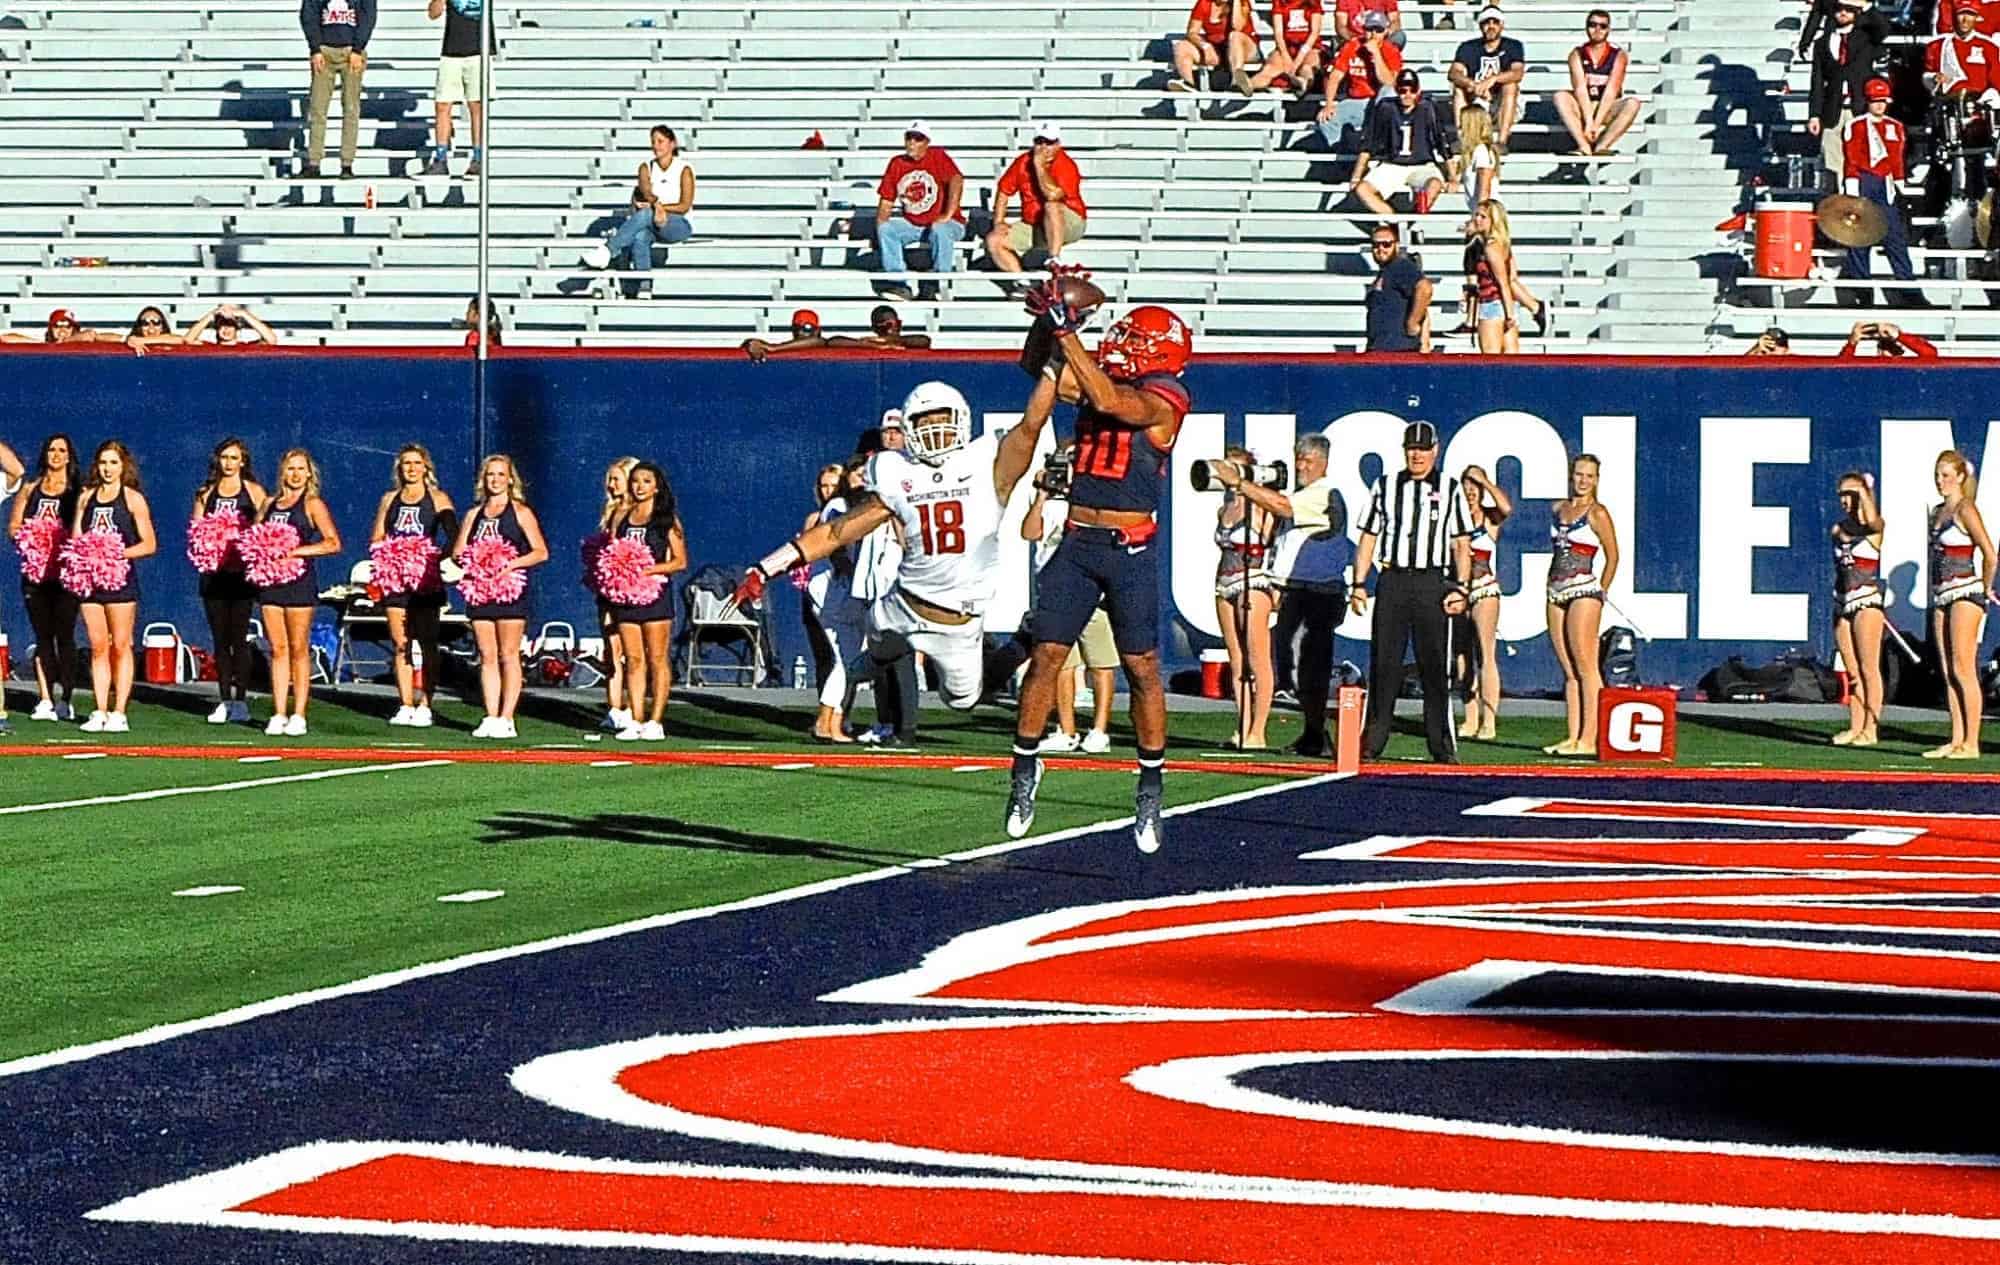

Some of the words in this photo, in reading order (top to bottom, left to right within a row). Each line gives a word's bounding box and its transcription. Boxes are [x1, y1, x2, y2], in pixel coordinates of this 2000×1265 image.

[1399, 126, 1413, 156] 1
[394, 507, 425, 535] A
[914, 500, 966, 556] 18
[1608, 701, 1664, 753] G
